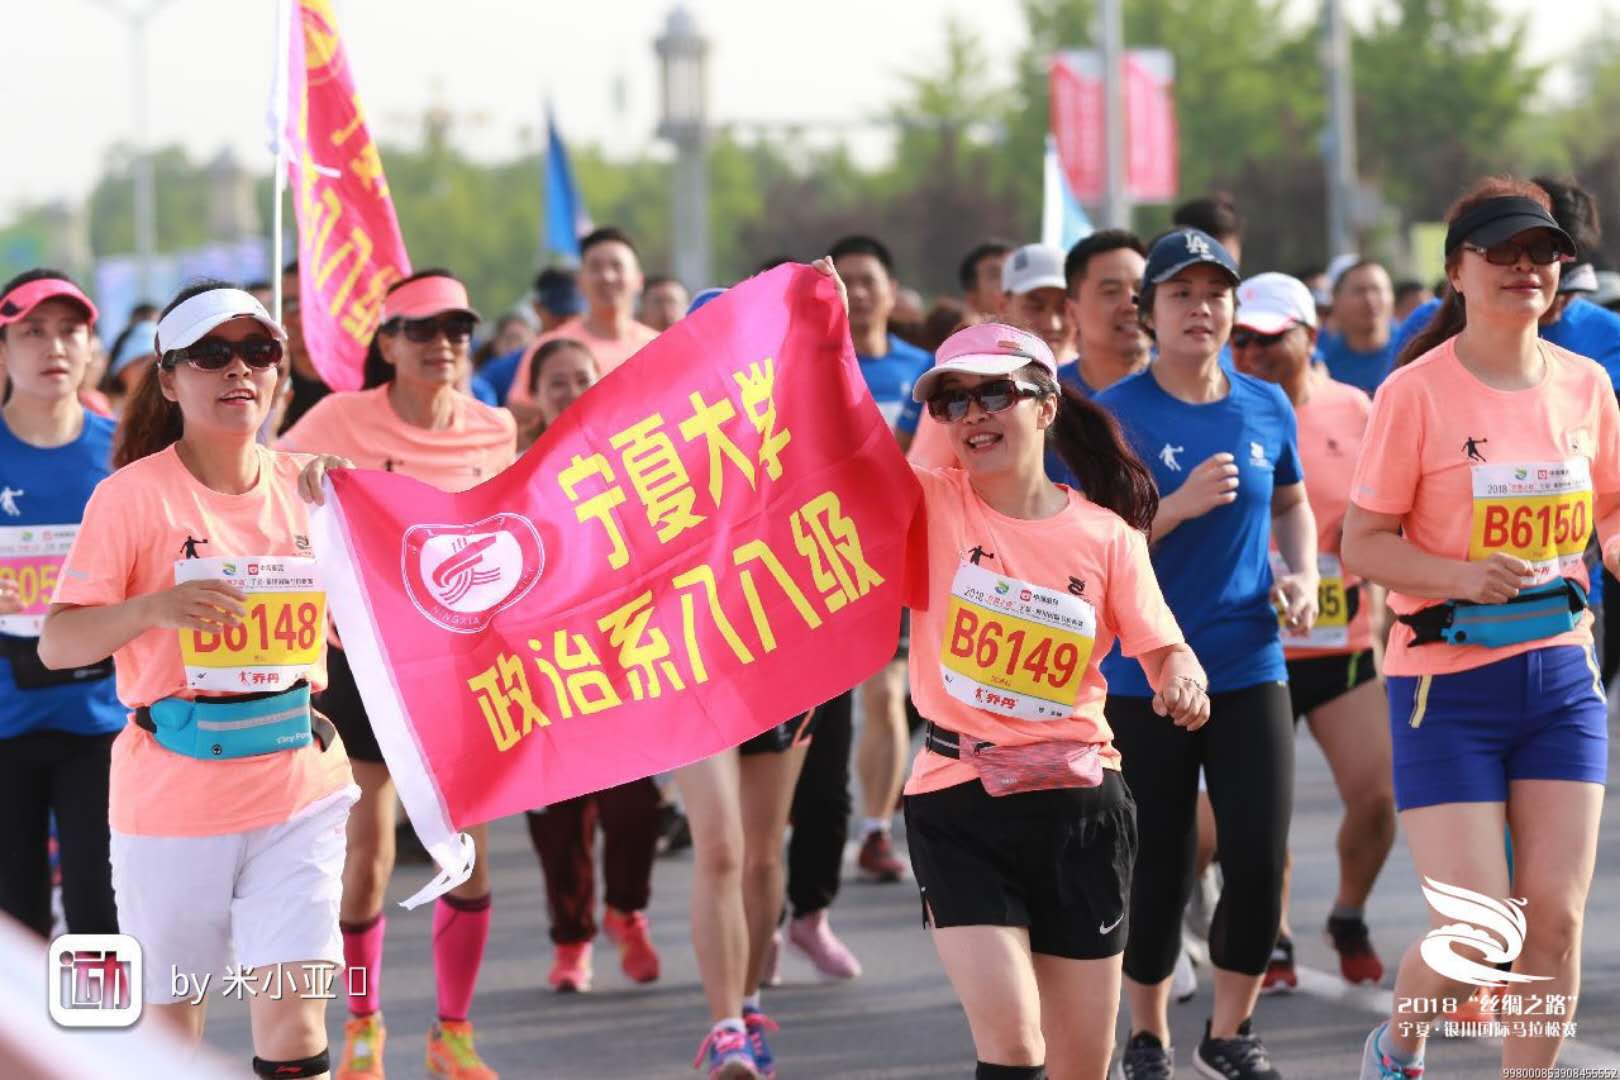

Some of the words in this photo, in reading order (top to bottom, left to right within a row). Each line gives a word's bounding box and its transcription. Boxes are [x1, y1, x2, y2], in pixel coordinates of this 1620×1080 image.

[557, 357, 792, 571] 宁夏大学
[1482, 500, 1586, 549] B6150
[467, 490, 886, 753] 政治系八八级
[950, 607, 1079, 689] B6149
